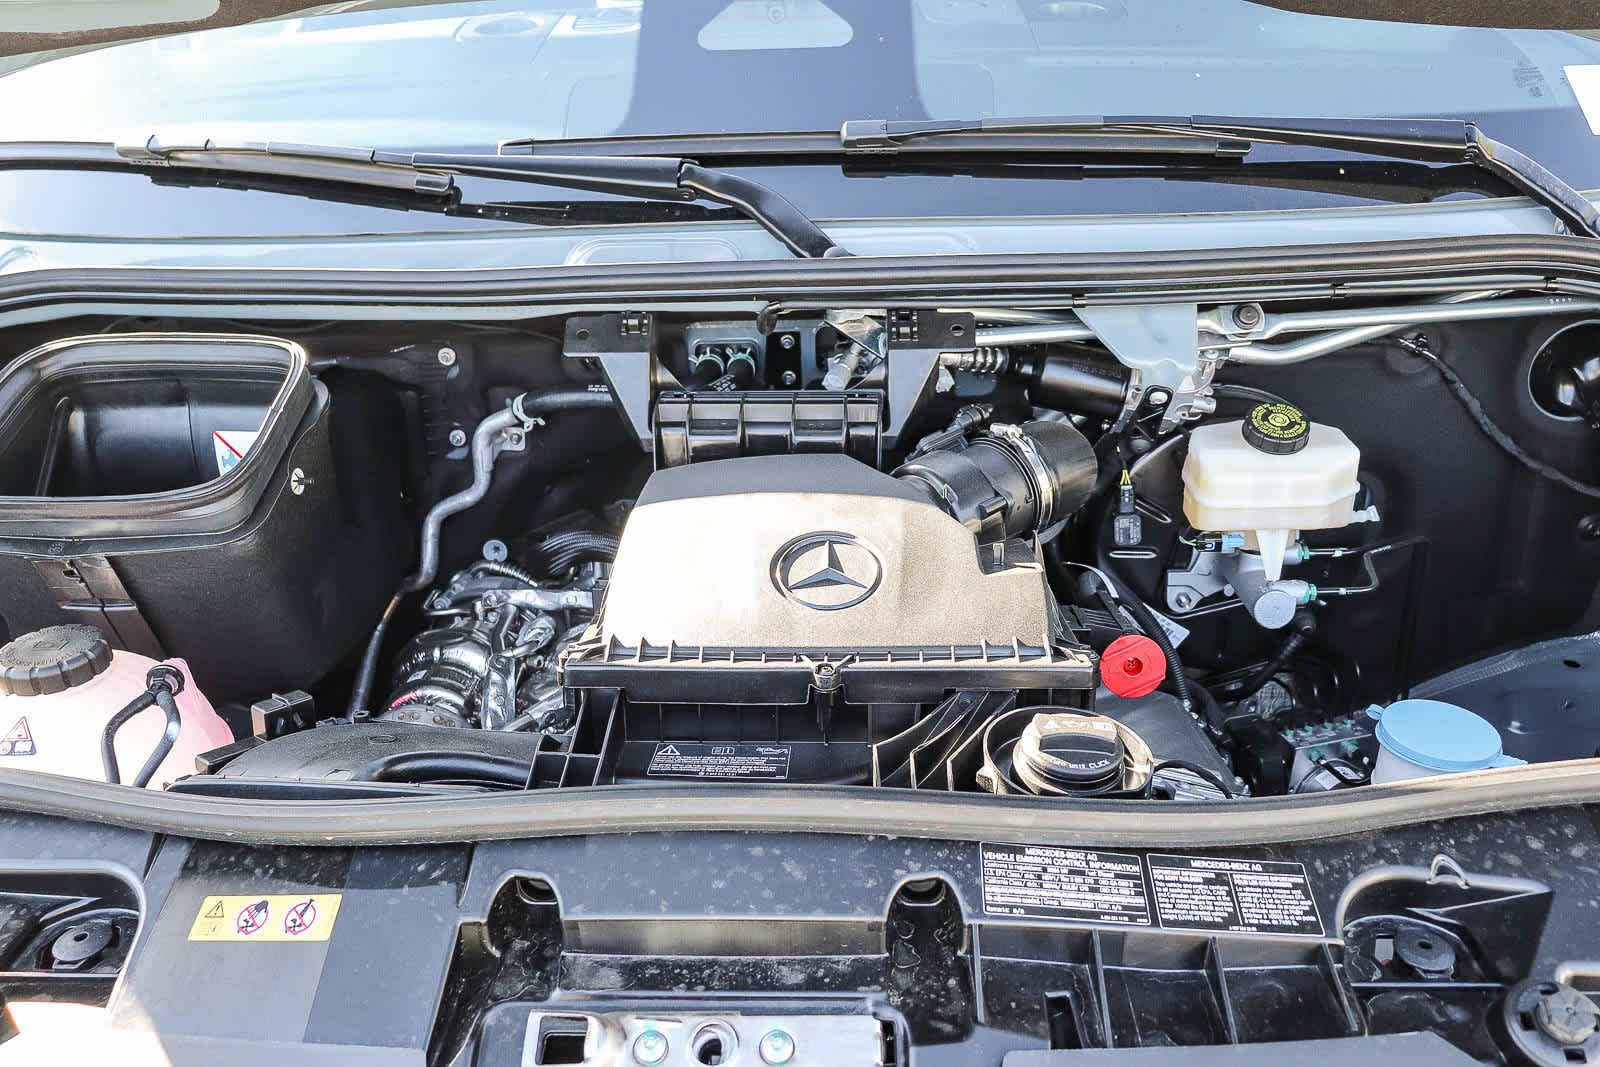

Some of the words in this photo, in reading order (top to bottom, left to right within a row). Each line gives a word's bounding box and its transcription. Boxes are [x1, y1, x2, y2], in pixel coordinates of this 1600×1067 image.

[1024, 847, 1085, 859] MERCEDES-BENZ
[983, 851, 1014, 861] VEHICLE
[1015, 854, 1052, 864] EMISSION
[1052, 857, 1088, 867] CONTROL
[1088, 860, 1139, 871] INFORMATION
[1190, 859, 1250, 870] MERCEDES-BENZ
[1250, 863, 1262, 871] AG
